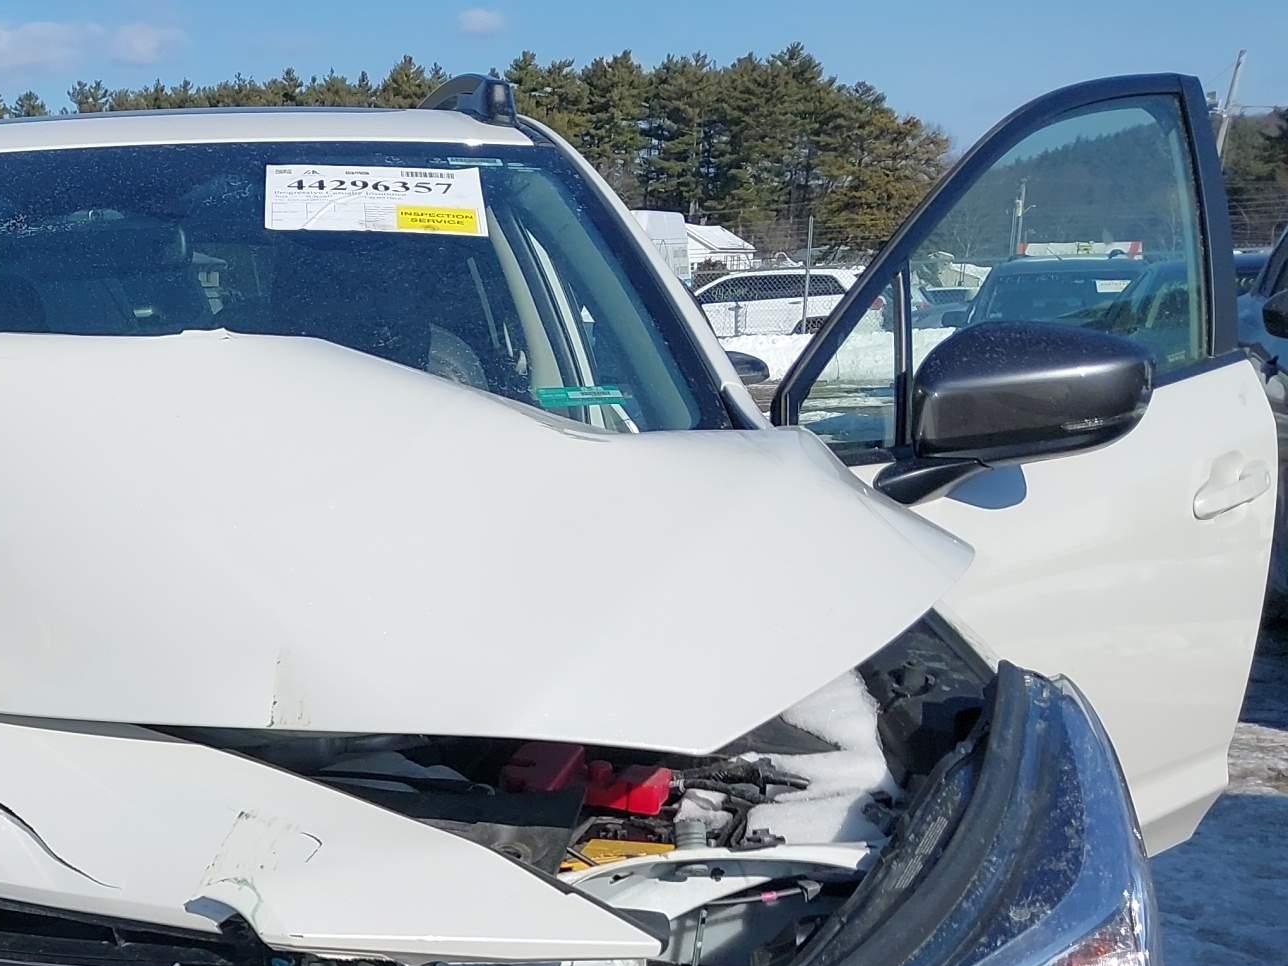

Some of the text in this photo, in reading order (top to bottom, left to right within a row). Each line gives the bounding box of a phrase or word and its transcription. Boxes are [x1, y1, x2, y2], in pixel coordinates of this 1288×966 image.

[287, 179, 453, 194] 44296357
[400, 211, 473, 219] INSPECTION
[410, 217, 465, 226] SERVICE
